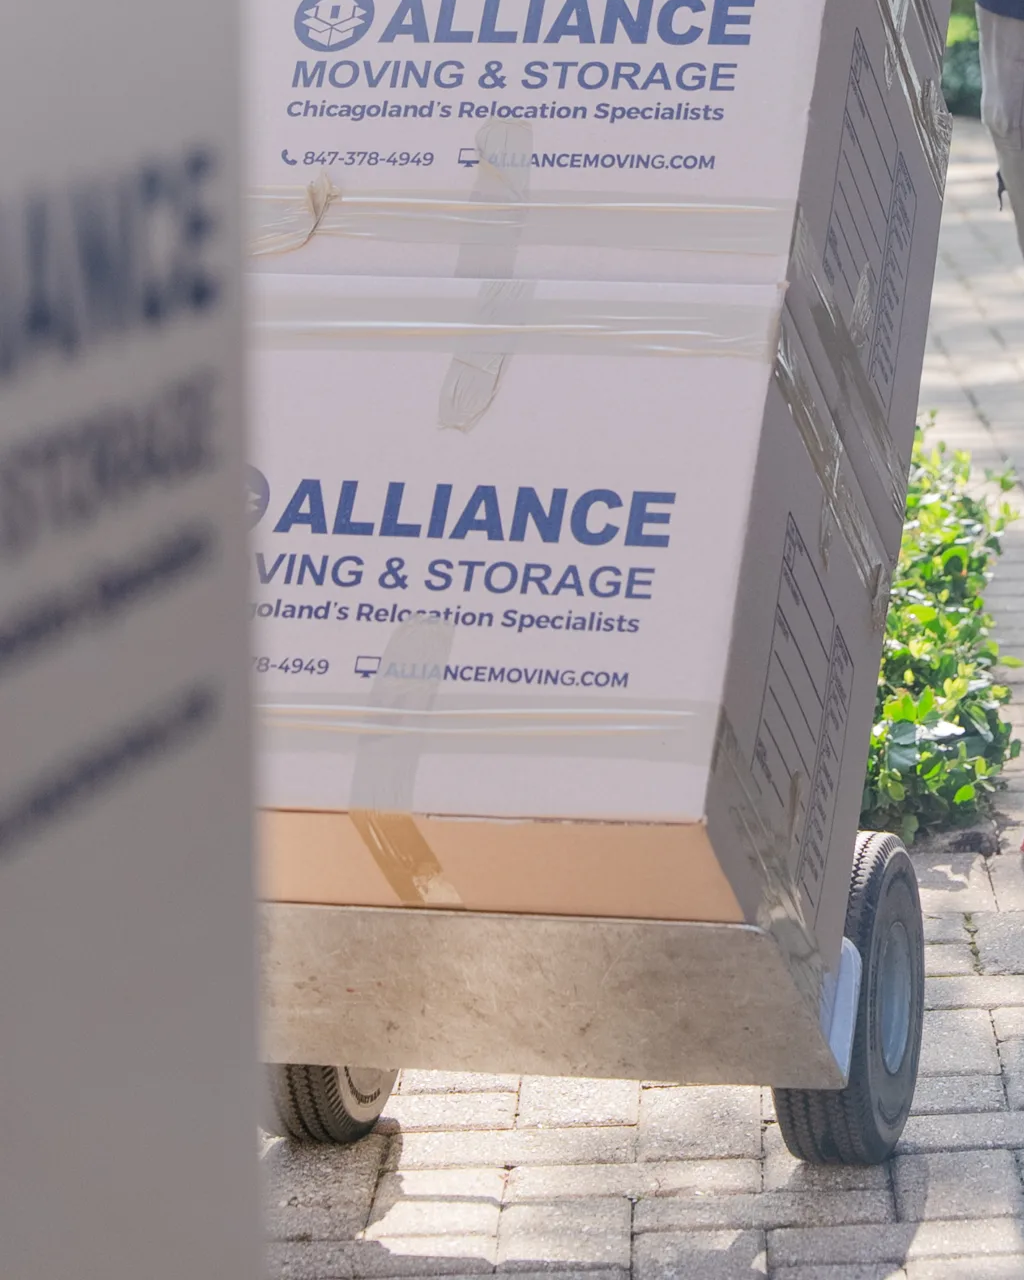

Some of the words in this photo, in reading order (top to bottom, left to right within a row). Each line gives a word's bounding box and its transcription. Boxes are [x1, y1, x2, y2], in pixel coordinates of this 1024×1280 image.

[291, 60, 465, 90] MOVING
[477, 60, 507, 91] &
[521, 61, 738, 92] STORAGE
[286, 100, 452, 122] Chicagoland's
[457, 100, 588, 121] Relocation
[593, 102, 725, 124] Specialists
[302, 150, 434, 167] 847-378-4949
[272, 478, 677, 549] ALLIANCE
[254, 552, 365, 588] VING
[377, 557, 409, 591] &
[423, 559, 656, 601] STORAGE
[249, 598, 350, 622] oland's
[500, 609, 641, 635] Specialists
